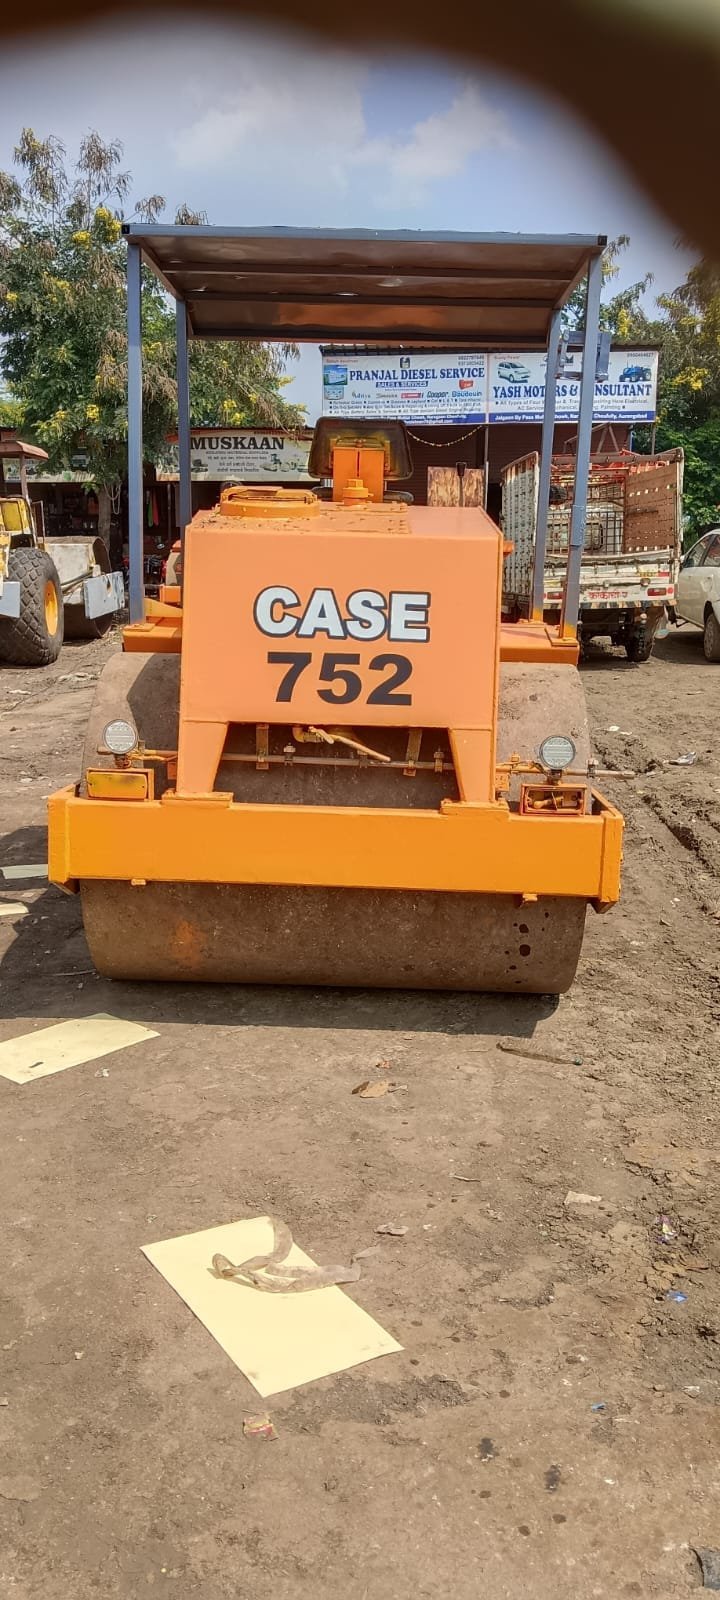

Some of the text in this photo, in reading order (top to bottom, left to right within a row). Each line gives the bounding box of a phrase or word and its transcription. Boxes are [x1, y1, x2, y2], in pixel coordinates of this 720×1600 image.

[349, 367, 485, 381] PRANJAL DIESEL SERVICE
[493, 384, 652, 398] YASH MOTRS & NSULTANT
[190, 436, 285, 450] MUSKAAN
[252, 585, 431, 643] CASE
[267, 651, 413, 706] 752
